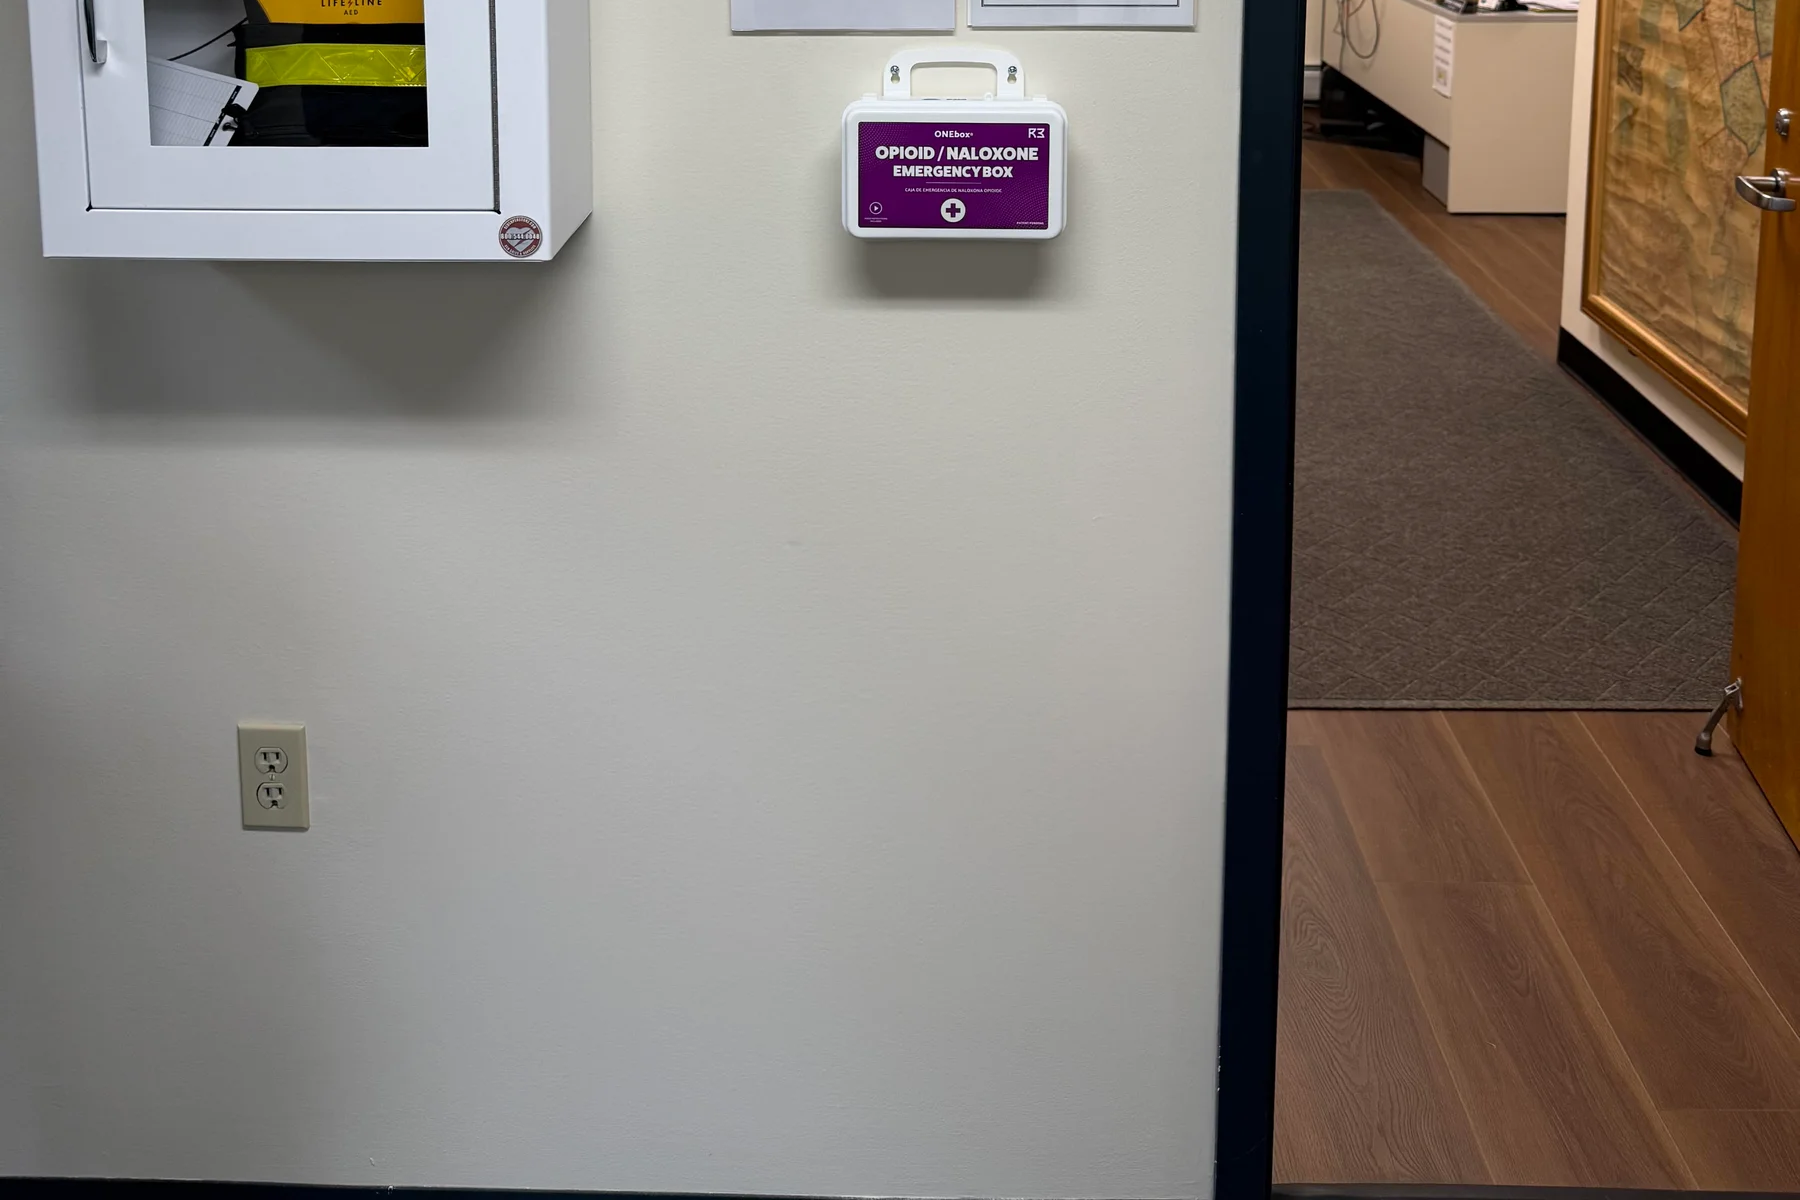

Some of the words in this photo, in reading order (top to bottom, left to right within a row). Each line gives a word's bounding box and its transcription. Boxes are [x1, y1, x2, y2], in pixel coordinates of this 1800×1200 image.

[875, 145, 936, 160] OPIOID
[936, 145, 945, 162] /
[946, 146, 1039, 160] NALOXONE
[893, 165, 982, 177] EMERGENCY
[982, 166, 1013, 178] BOX
